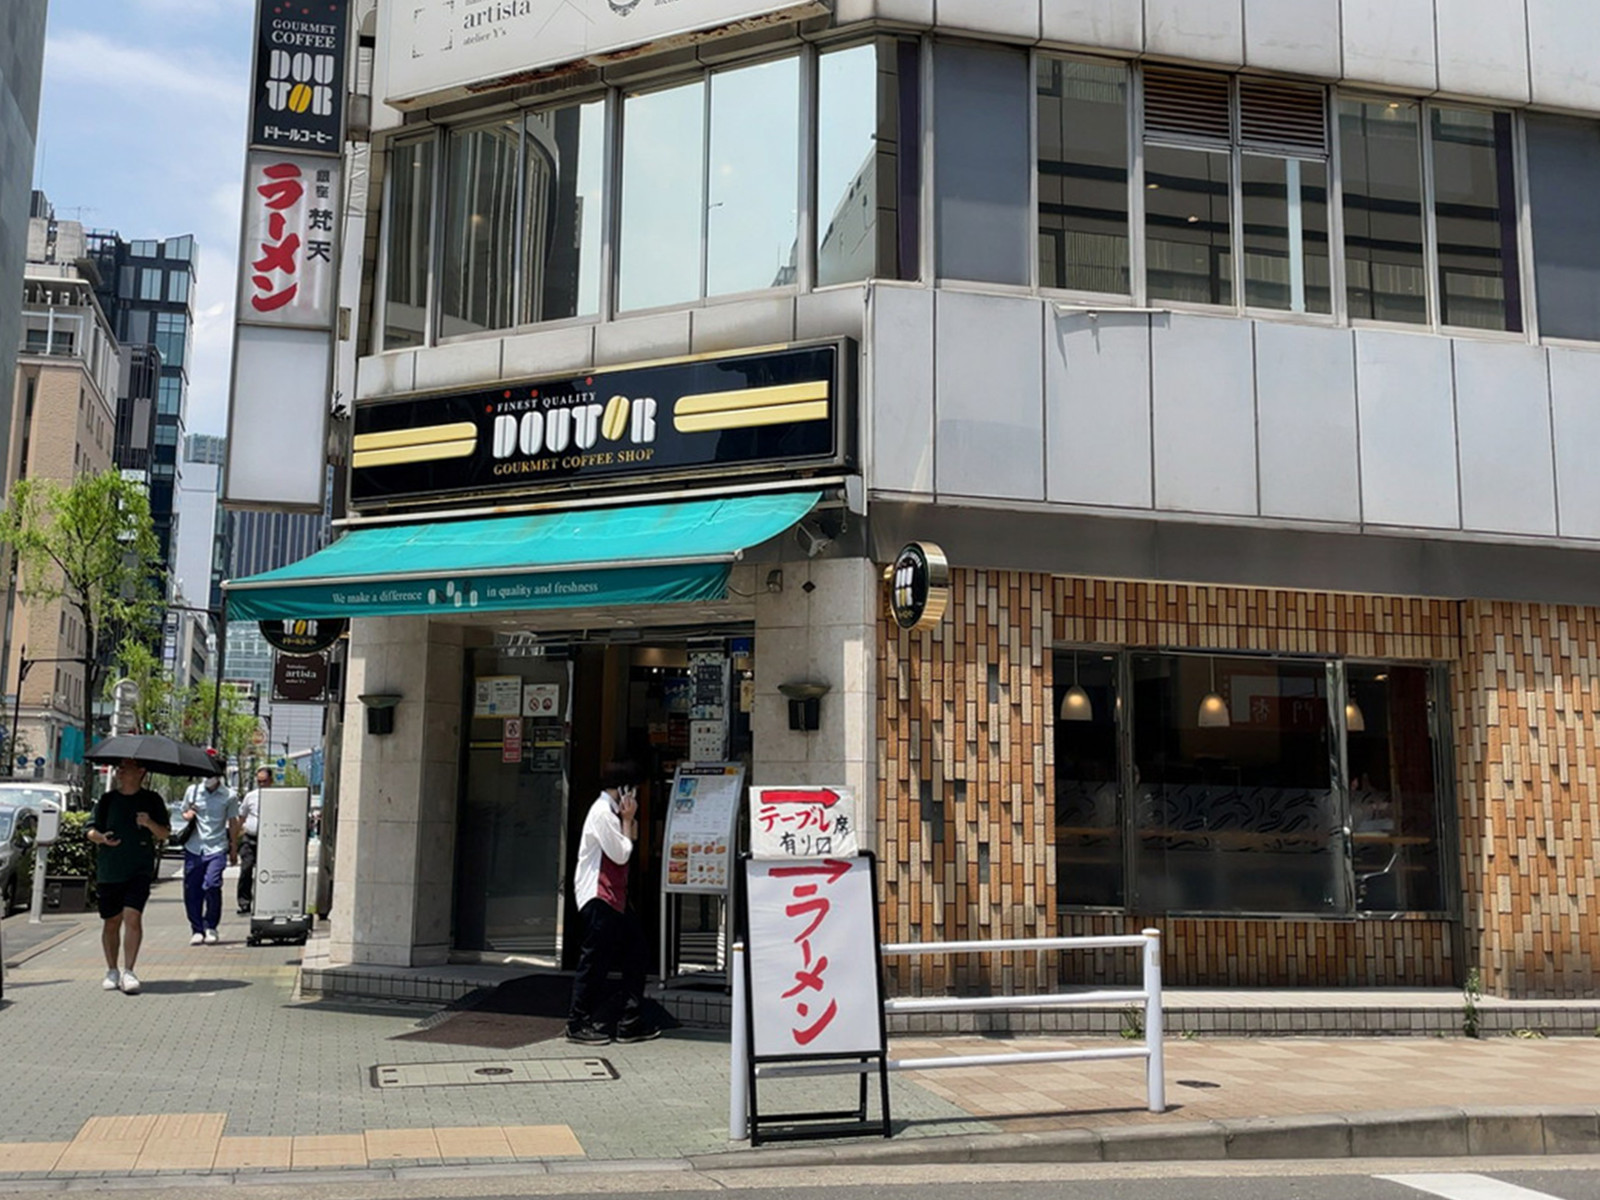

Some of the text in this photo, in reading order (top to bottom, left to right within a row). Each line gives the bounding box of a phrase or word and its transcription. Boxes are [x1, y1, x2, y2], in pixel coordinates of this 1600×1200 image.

[272, 19, 337, 35] GOURMET
[463, 0, 531, 29] artista
[271, 30, 336, 49] COFFEE
[269, 49, 335, 84] DOU
[265, 80, 333, 116] TOR
[263, 125, 333, 144] ドトールコーヒー
[251, 162, 304, 313] ラーメン
[306, 207, 333, 263] 梵天
[497, 391, 597, 412] FINEST QUALITY
[492, 395, 658, 459] DOUTOR
[493, 448, 655, 476] GOURMET COFFEE SHOP
[347, 591, 371, 604] make
[372, 593, 378, 602] a
[379, 589, 423, 603] difference
[486, 585, 497, 598] in
[498, 583, 531, 600] quality
[533, 582, 552, 595] and
[554, 581, 599, 594] freshness
[780, 883, 838, 1047] ラーメン
